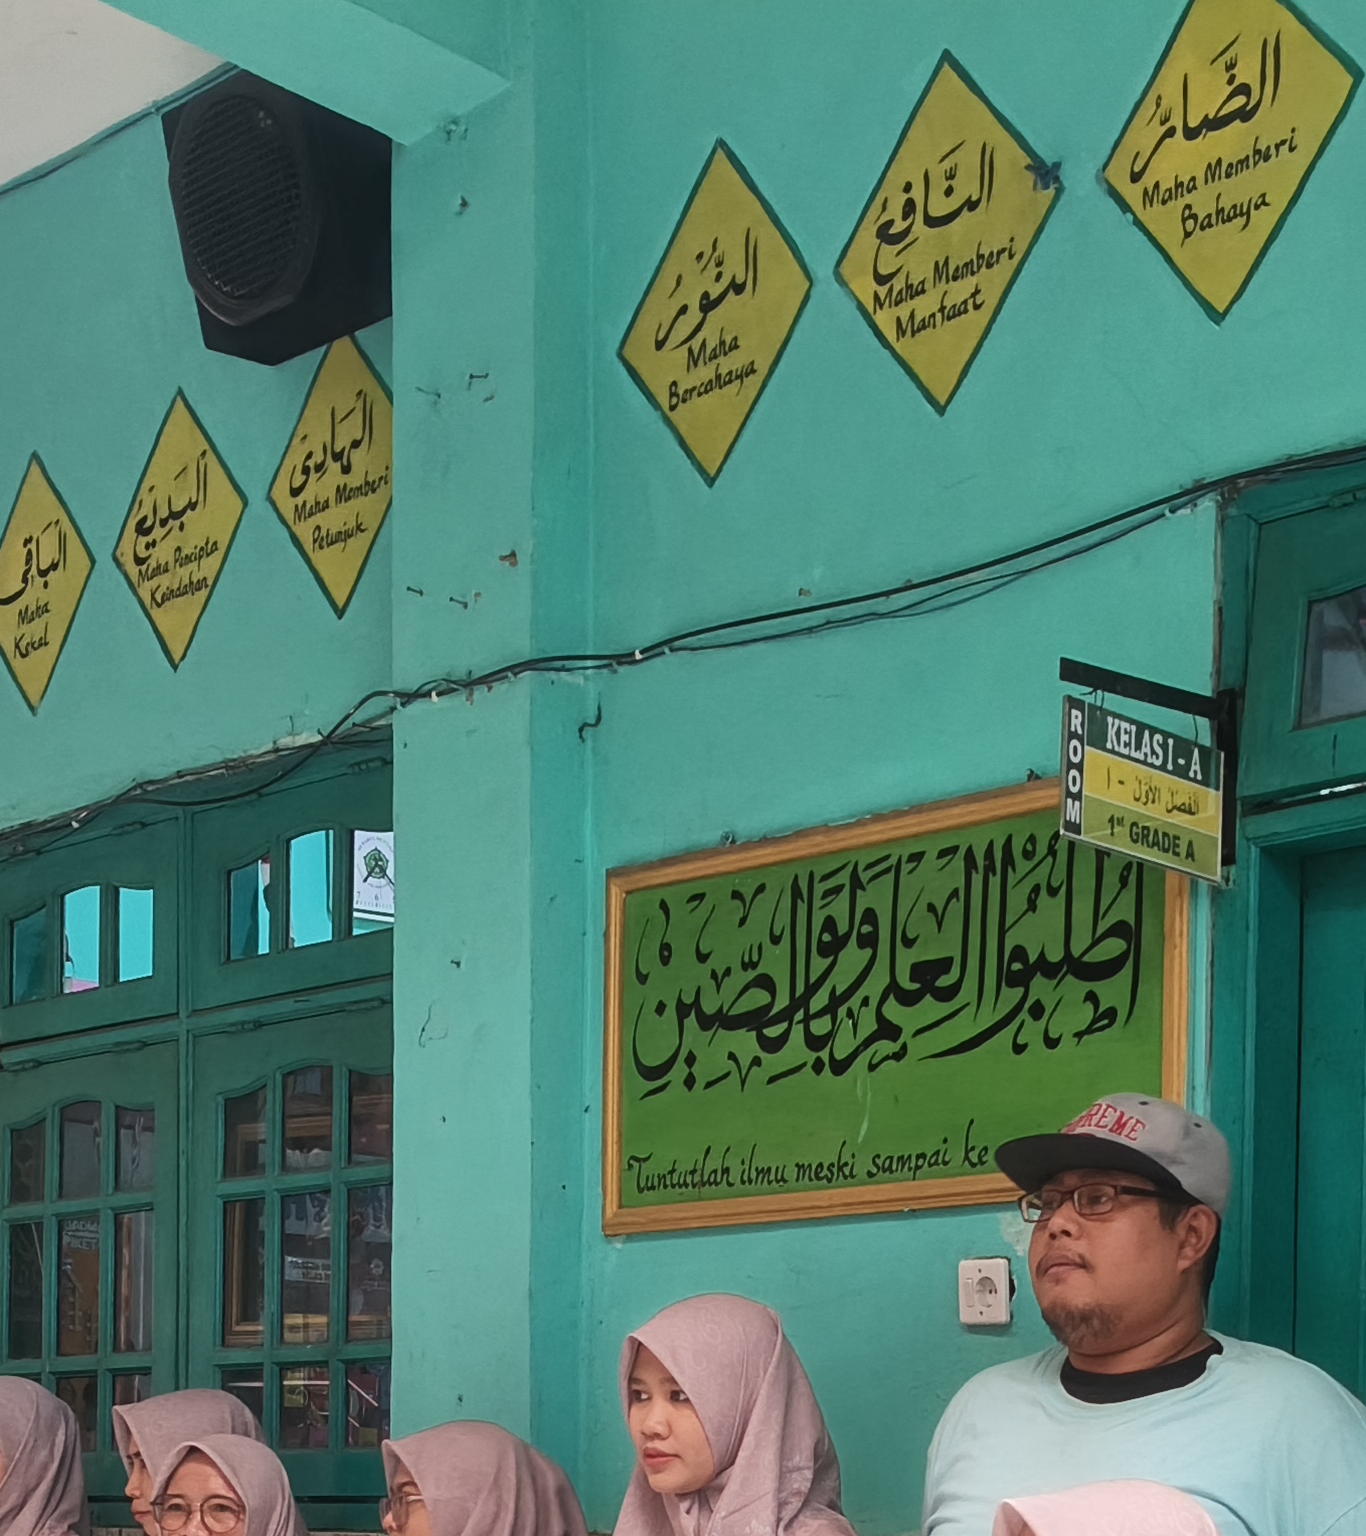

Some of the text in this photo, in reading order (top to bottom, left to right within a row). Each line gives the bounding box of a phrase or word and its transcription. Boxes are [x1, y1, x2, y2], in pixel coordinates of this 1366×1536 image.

[1142, 127, 1299, 211] Maha Memberi
[1180, 191, 1271, 248] Bahaya
[872, 236, 1017, 316] Maha Memberi
[895, 283, 985, 343] Manfaat
[686, 327, 740, 373] Maha
[668, 359, 758, 413] Bercahaya
[293, 465, 389, 526] Maha Memberi
[311, 511, 369, 553] Petunjuk
[137, 536, 219, 588] Maha Pencipta
[17, 597, 51, 628] Maha
[149, 570, 209, 610] Keindahan
[1065, 708, 1083, 825] ROOM
[1106, 716, 1163, 767] KELAS
[1166, 738, 1174, 771] I
[1188, 747, 1203, 781] A
[1128, 821, 1182, 858] GRADE
[1185, 839, 1197, 863] A
[1063, 1102, 1147, 1142] REME
[627, 1118, 991, 1195] Tuntutlah ilmu meski sampai ke
